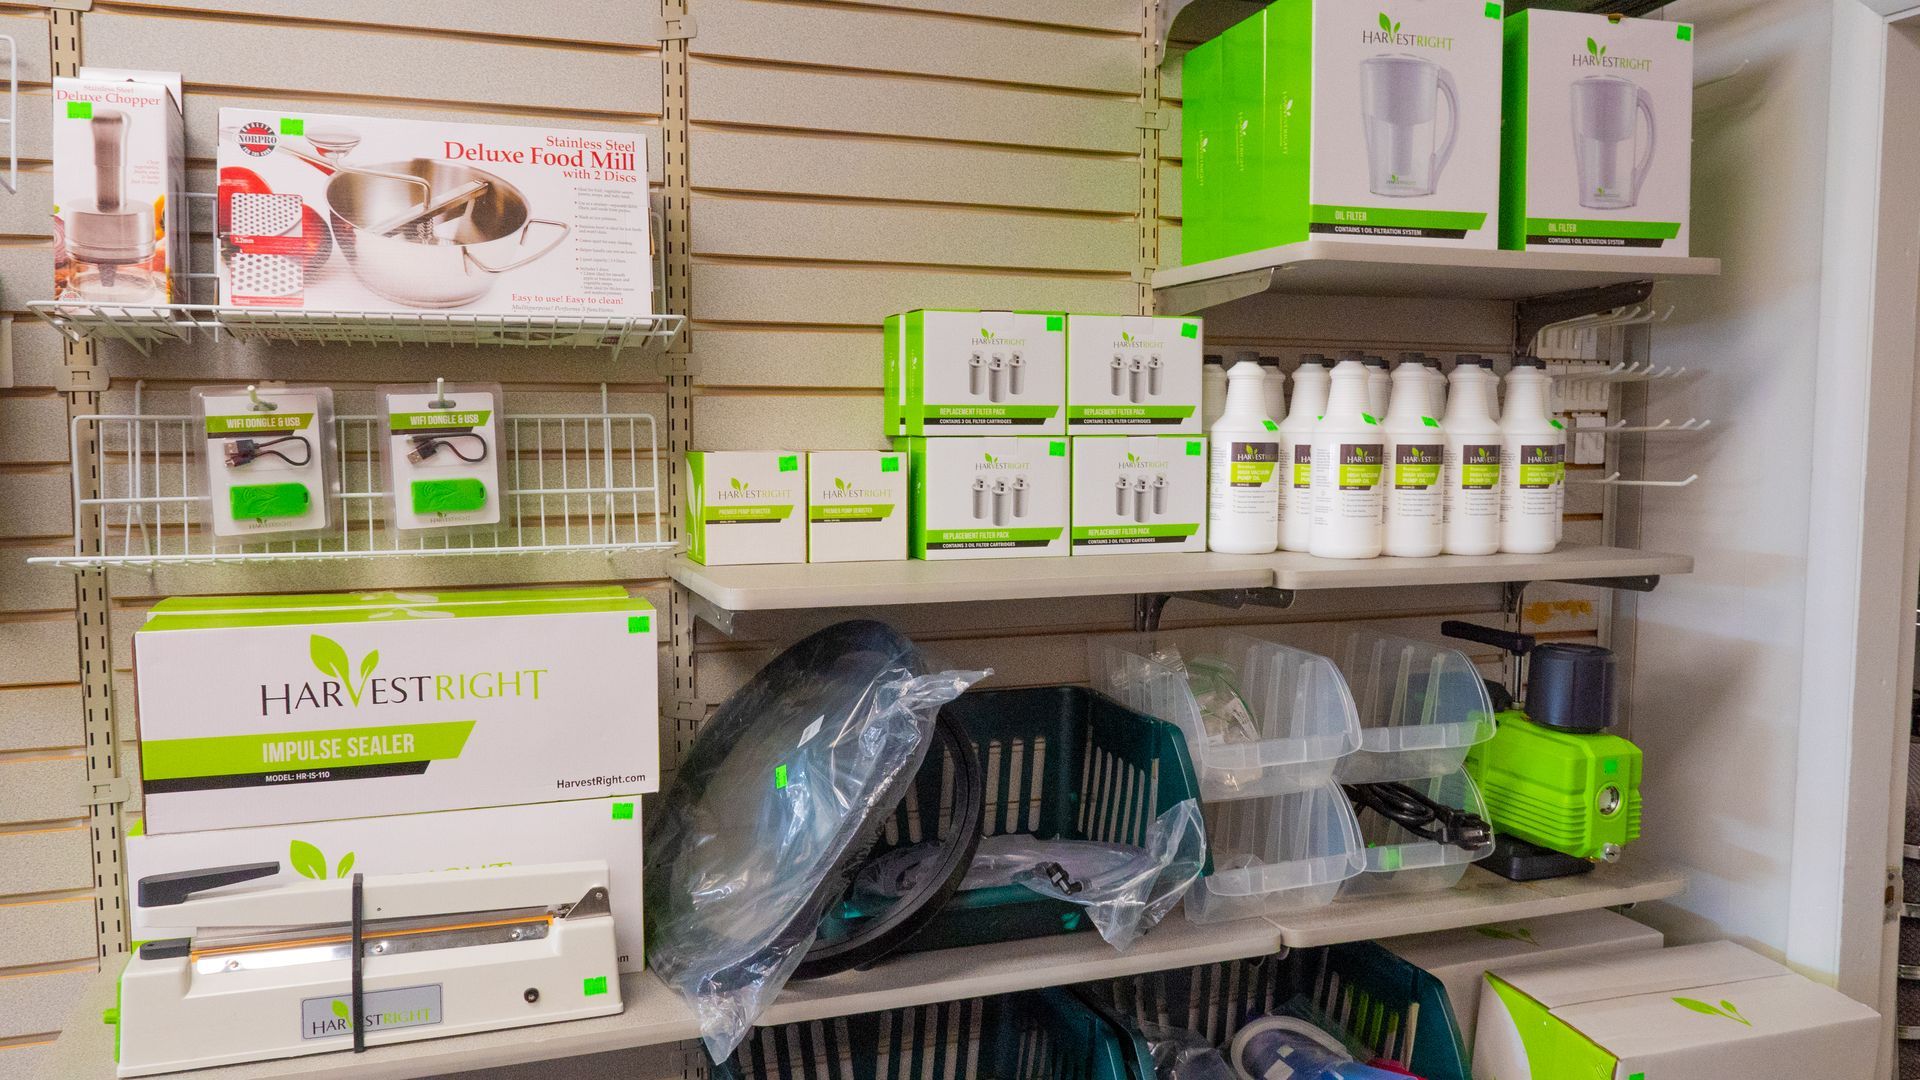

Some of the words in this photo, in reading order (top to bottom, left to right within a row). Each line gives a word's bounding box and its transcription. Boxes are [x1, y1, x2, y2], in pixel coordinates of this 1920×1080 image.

[1362, 30, 1455, 51] HARVESTRIGHT
[56, 90, 102, 103] Deluxe
[105, 93, 161, 108] Chopper
[238, 134, 277, 144] NORPRO
[546, 135, 602, 150] Stainless
[605, 140, 636, 153] Steel
[444, 141, 524, 164] Deluxe
[530, 147, 585, 168] Food
[590, 151, 636, 171] Mill
[563, 170, 591, 180] with
[593, 172, 602, 181] 2
[603, 172, 637, 184] Discs
[1334, 211, 1345, 221] OIL
[1346, 211, 1367, 222] FILTER
[1334, 225, 1360, 233] CONTAINS
[1374, 228, 1402, 236] FILTRATION
[1548, 223, 1558, 232] OIL
[1559, 223, 1577, 233] FILTER
[511, 294, 532, 305] Easy
[535, 295, 544, 303] to
[545, 295, 564, 304] use!
[566, 296, 586, 306] Easy
[588, 297, 597, 305] to
[598, 296, 625, 305] clean!
[992, 408, 1006, 416] PACK
[226, 418, 245, 428] WIFI
[246, 417, 276, 428] DONGLE
[277, 417, 284, 427] &
[284, 416, 301, 427] USB
[410, 416, 427, 426] WIFI
[427, 415, 456, 425] DONGLE
[457, 415, 463, 424] &
[464, 414, 480, 424] USB
[942, 532, 978, 540] REPLACEMENT
[261, 669, 548, 716] HARVESTRIGHT
[262, 737, 342, 764] IMPULSE
[347, 732, 415, 759] SEALER
[265, 773, 295, 782] MODEL:
[295, 770, 330, 780] HR-IS-110
[557, 773, 646, 789] HarvestRight.com
[312, 1007, 431, 1035] HARSTRIGHT
